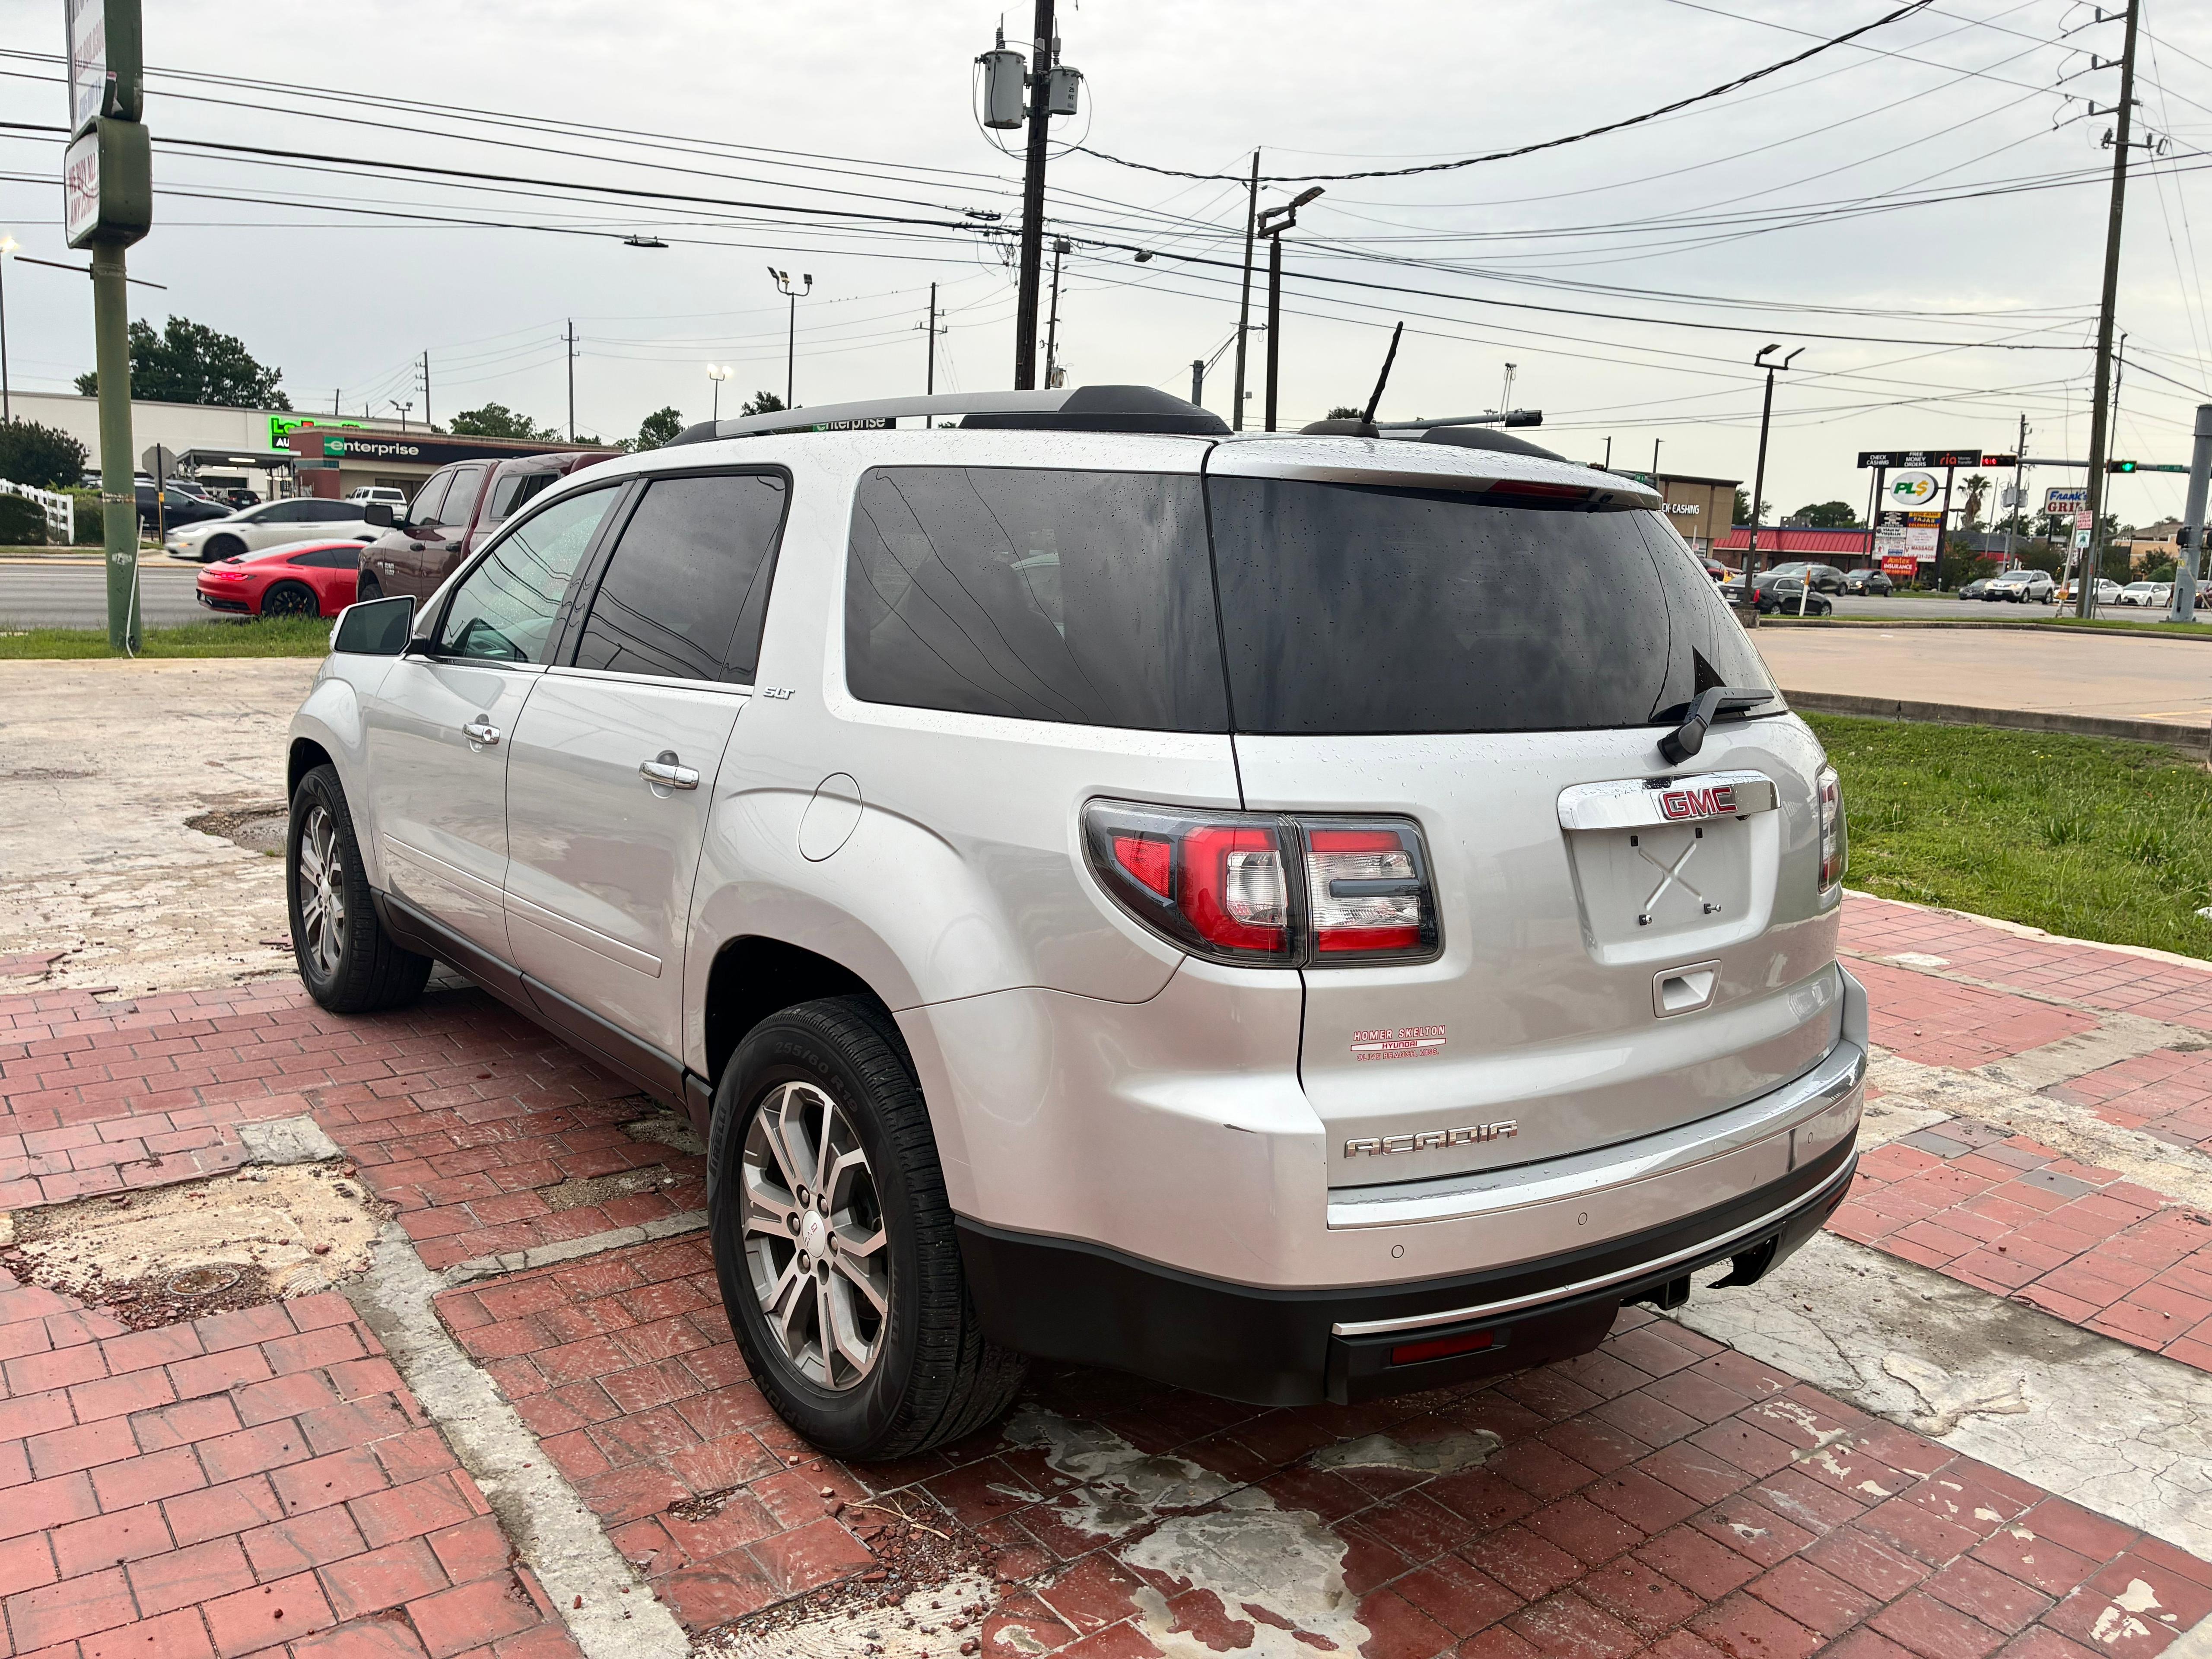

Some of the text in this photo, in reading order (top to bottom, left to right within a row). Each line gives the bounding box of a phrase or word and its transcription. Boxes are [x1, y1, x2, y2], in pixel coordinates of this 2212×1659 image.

[88, 152, 96, 184] ALL
[70, 195, 81, 227] ANY
[328, 440, 419, 456] enterprise
[1940, 453, 1957, 465] ria
[2050, 490, 2087, 501] Frank's
[1672, 503, 1700, 515] CASHING
[763, 686, 796, 700] SLT
[1659, 786, 1738, 820] GMC
[1353, 1025, 1446, 1041] HOMER SKELTON
[1382, 1041, 1417, 1049] HYUNDAI
[774, 1041, 829, 1074] 255/60
[1357, 1048, 1439, 1061] OLIVE BRANCH, MISS.
[1344, 1119, 1518, 1159] ACADIA
